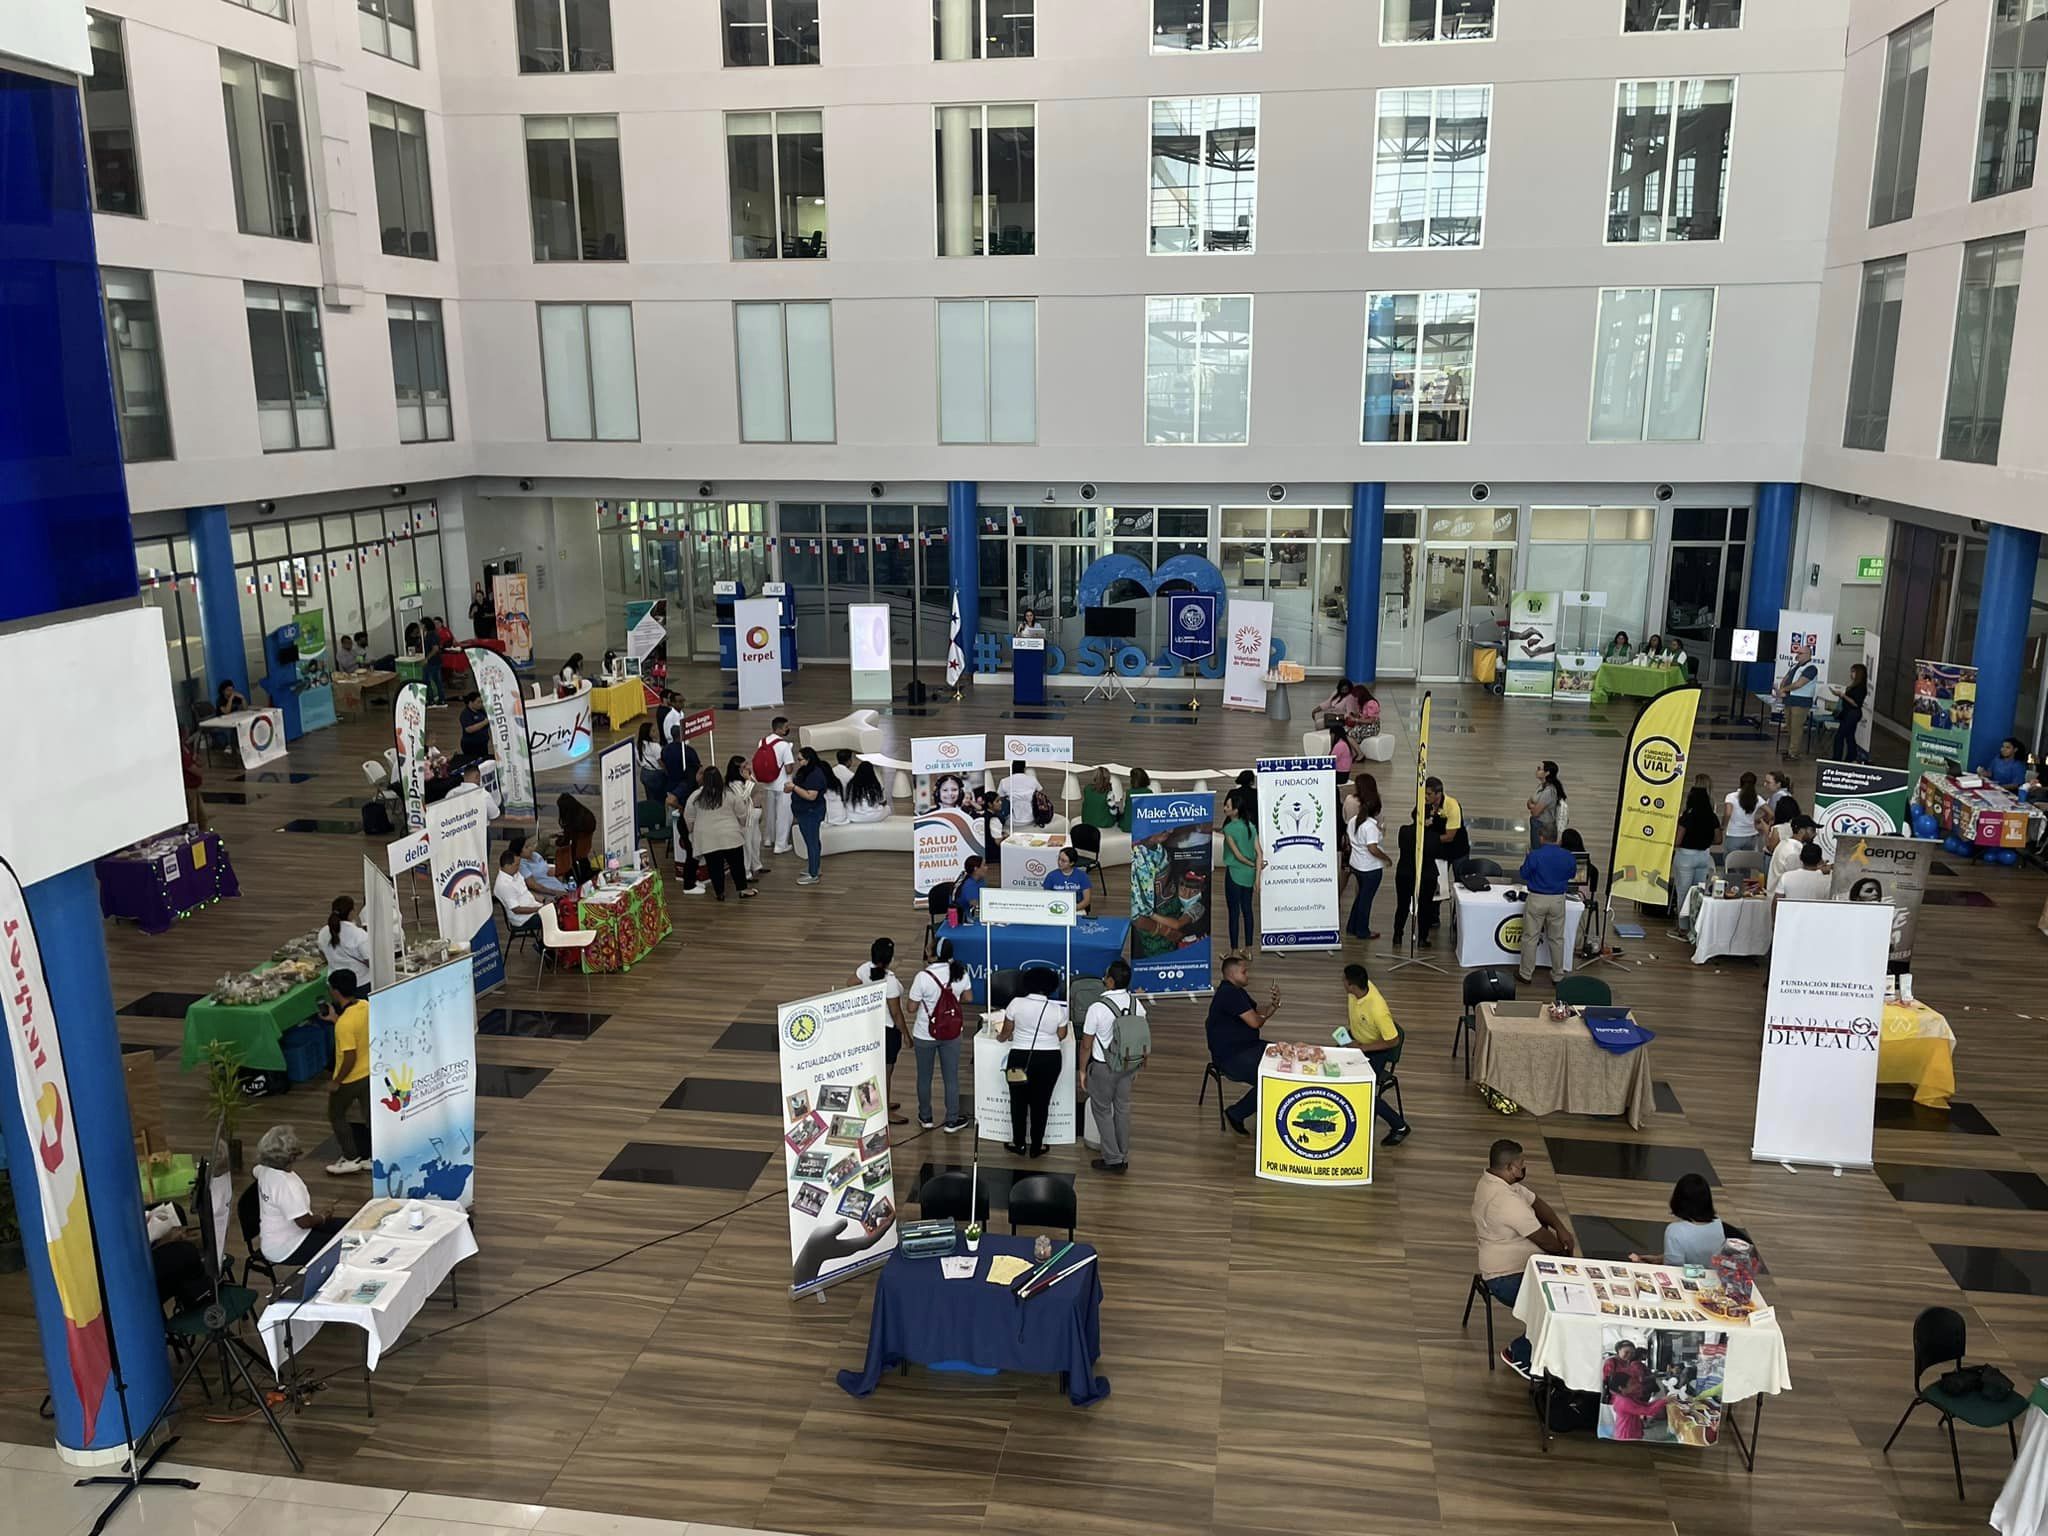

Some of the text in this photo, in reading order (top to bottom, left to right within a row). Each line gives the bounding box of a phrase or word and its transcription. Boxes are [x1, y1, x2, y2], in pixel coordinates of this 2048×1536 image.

[742, 651, 775, 664] terpel
[1644, 759, 1671, 773] VIAL
[1275, 777, 1319, 787] FUNDACIÓN
[919, 835, 958, 846] SALUD
[404, 844, 429, 864] delta
[919, 845, 958, 855] AUDITIVA
[1864, 848, 1916, 863] aenpa
[919, 858, 959, 869] FAMILIA
[1297, 862, 1327, 870] EDUCACIÓN
[1781, 979, 1873, 991] FUNDACIÓN BENÉFICA
[823, 991, 884, 1016] PATRONATO LUZ DEL CIEGO
[1768, 1029, 1876, 1051] DEVEAUX
[797, 1052, 842, 1071] ACTUALIZACIÓN
[847, 1041, 880, 1057] SUPERACIÓN
[411, 1059, 469, 1089] ENCUENTRO
[814, 1074, 826, 1083] DEL
[827, 1071, 835, 1079] NO
[1266, 1160, 1363, 1176] POR UN PANAMÁ LIBRE DE DROGAS
